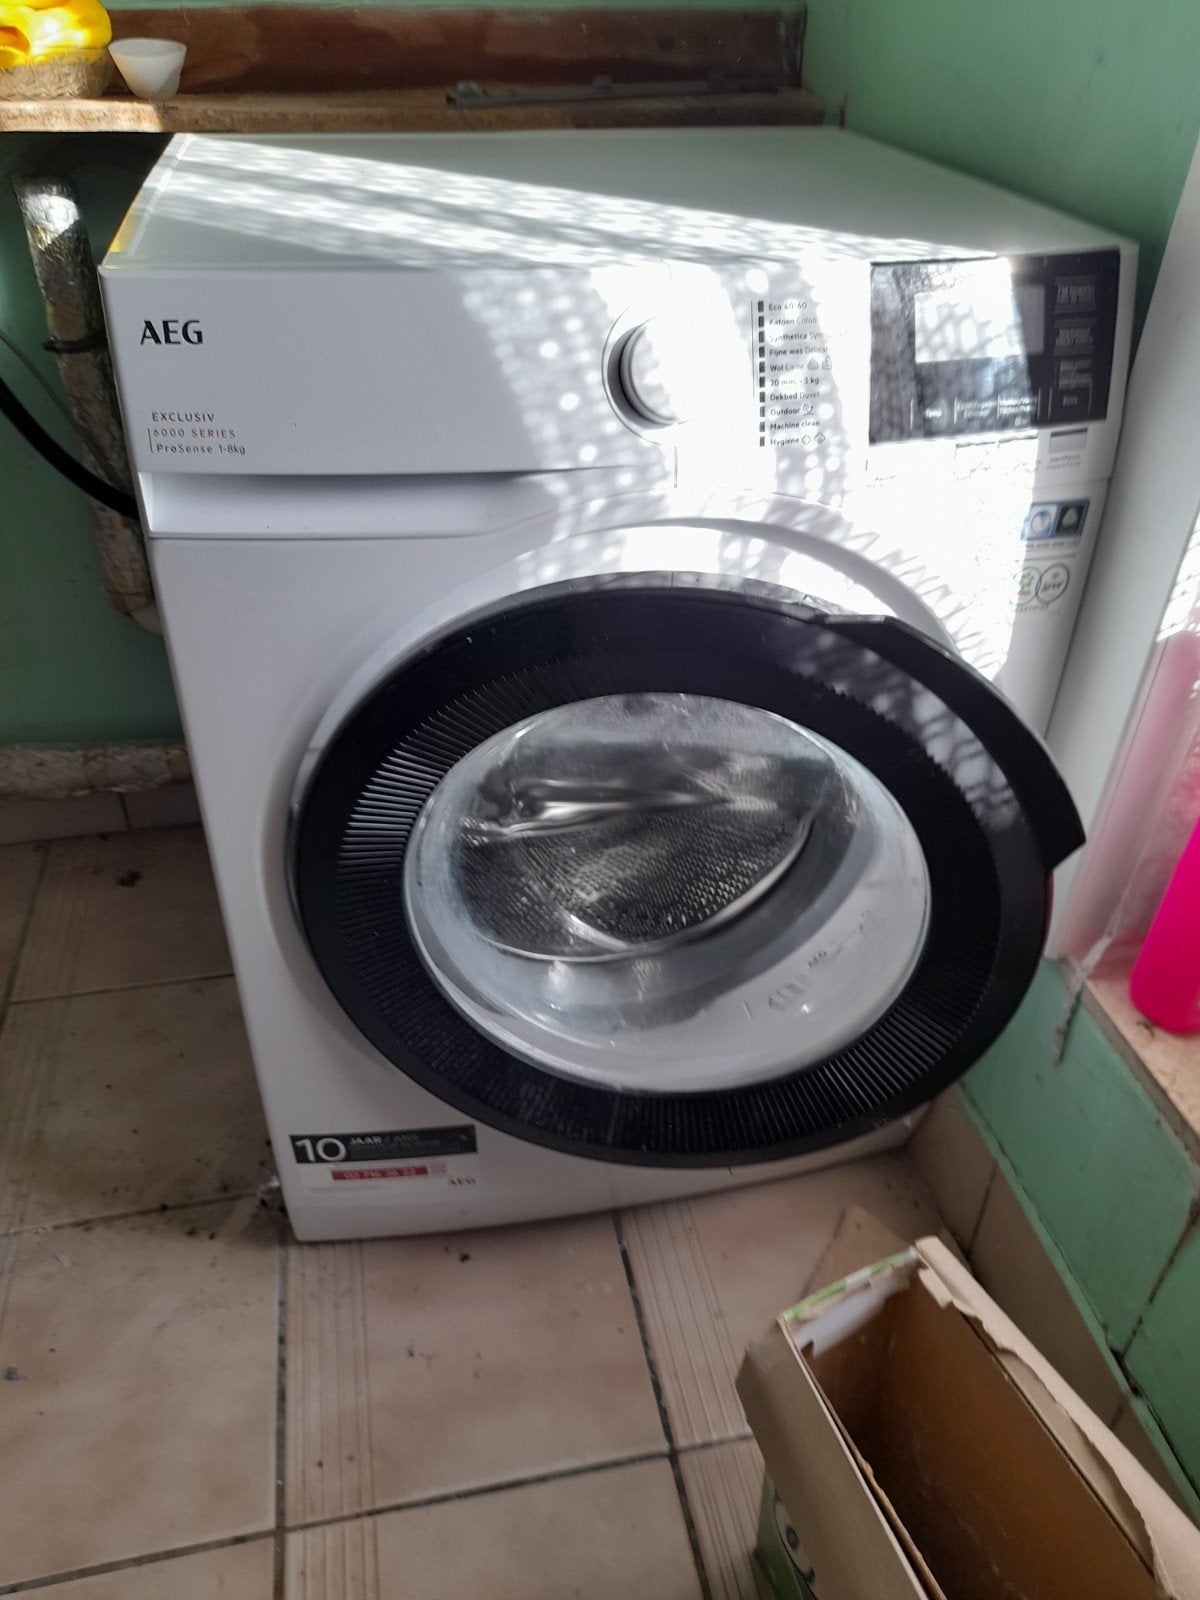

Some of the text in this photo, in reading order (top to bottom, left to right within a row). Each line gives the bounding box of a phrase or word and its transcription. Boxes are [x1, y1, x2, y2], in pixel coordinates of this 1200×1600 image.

[768, 303, 782, 312] Eco
[140, 319, 203, 345] AEG
[769, 348, 788, 358] Fijne
[810, 376, 820, 386] kg
[770, 391, 798, 401] Dekbed
[151, 411, 215, 422] EXCLUSIV
[770, 407, 800, 416] Outdoor
[769, 420, 820, 431] Machine clean
[153, 428, 236, 439] 6000 SERIES
[156, 442, 213, 454] ProSense
[294, 1137, 347, 1163] 10
